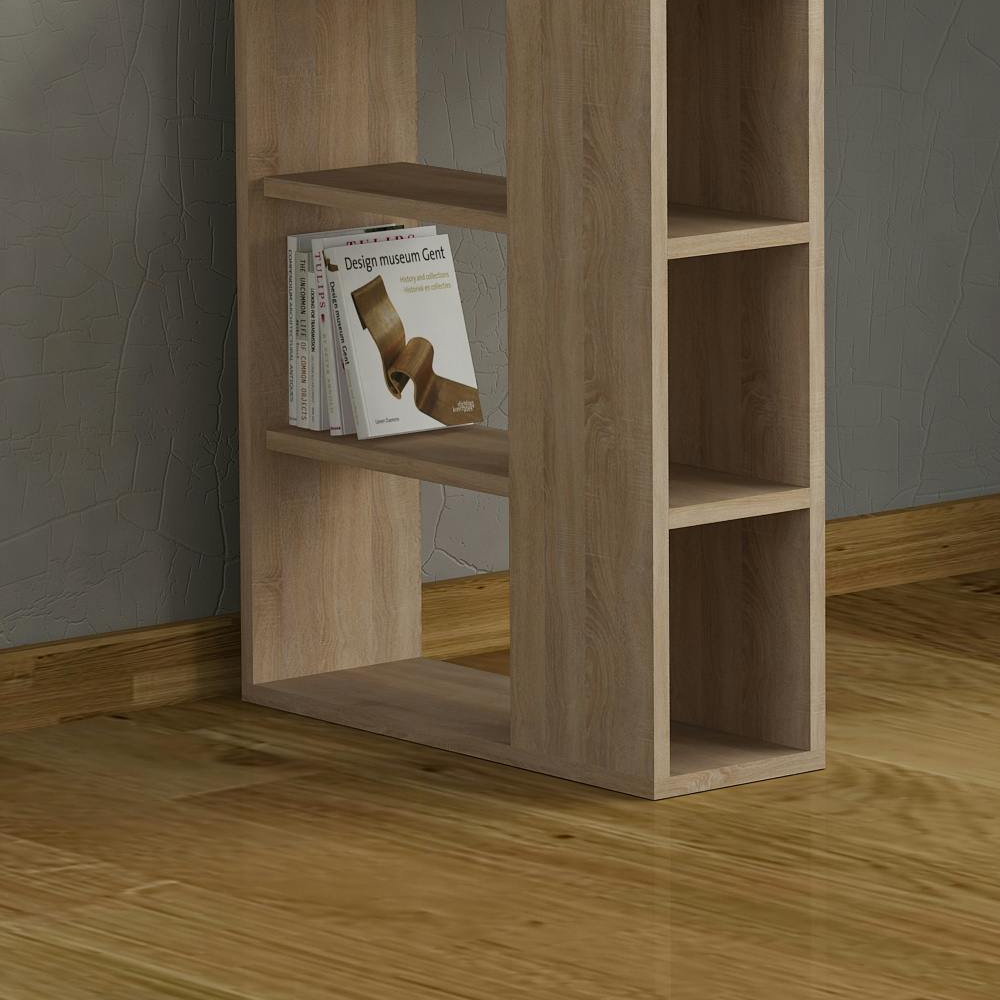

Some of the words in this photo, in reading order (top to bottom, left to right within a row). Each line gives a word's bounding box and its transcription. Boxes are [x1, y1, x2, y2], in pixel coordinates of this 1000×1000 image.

[344, 255, 378, 272] Design
[380, 250, 421, 267] museum
[422, 246, 446, 261] Gent
[314, 252, 326, 308] TULIPS
[330, 282, 340, 309] Design
[335, 310, 346, 344] museum
[342, 346, 350, 365] Gent
[300, 342, 306, 351] OF
